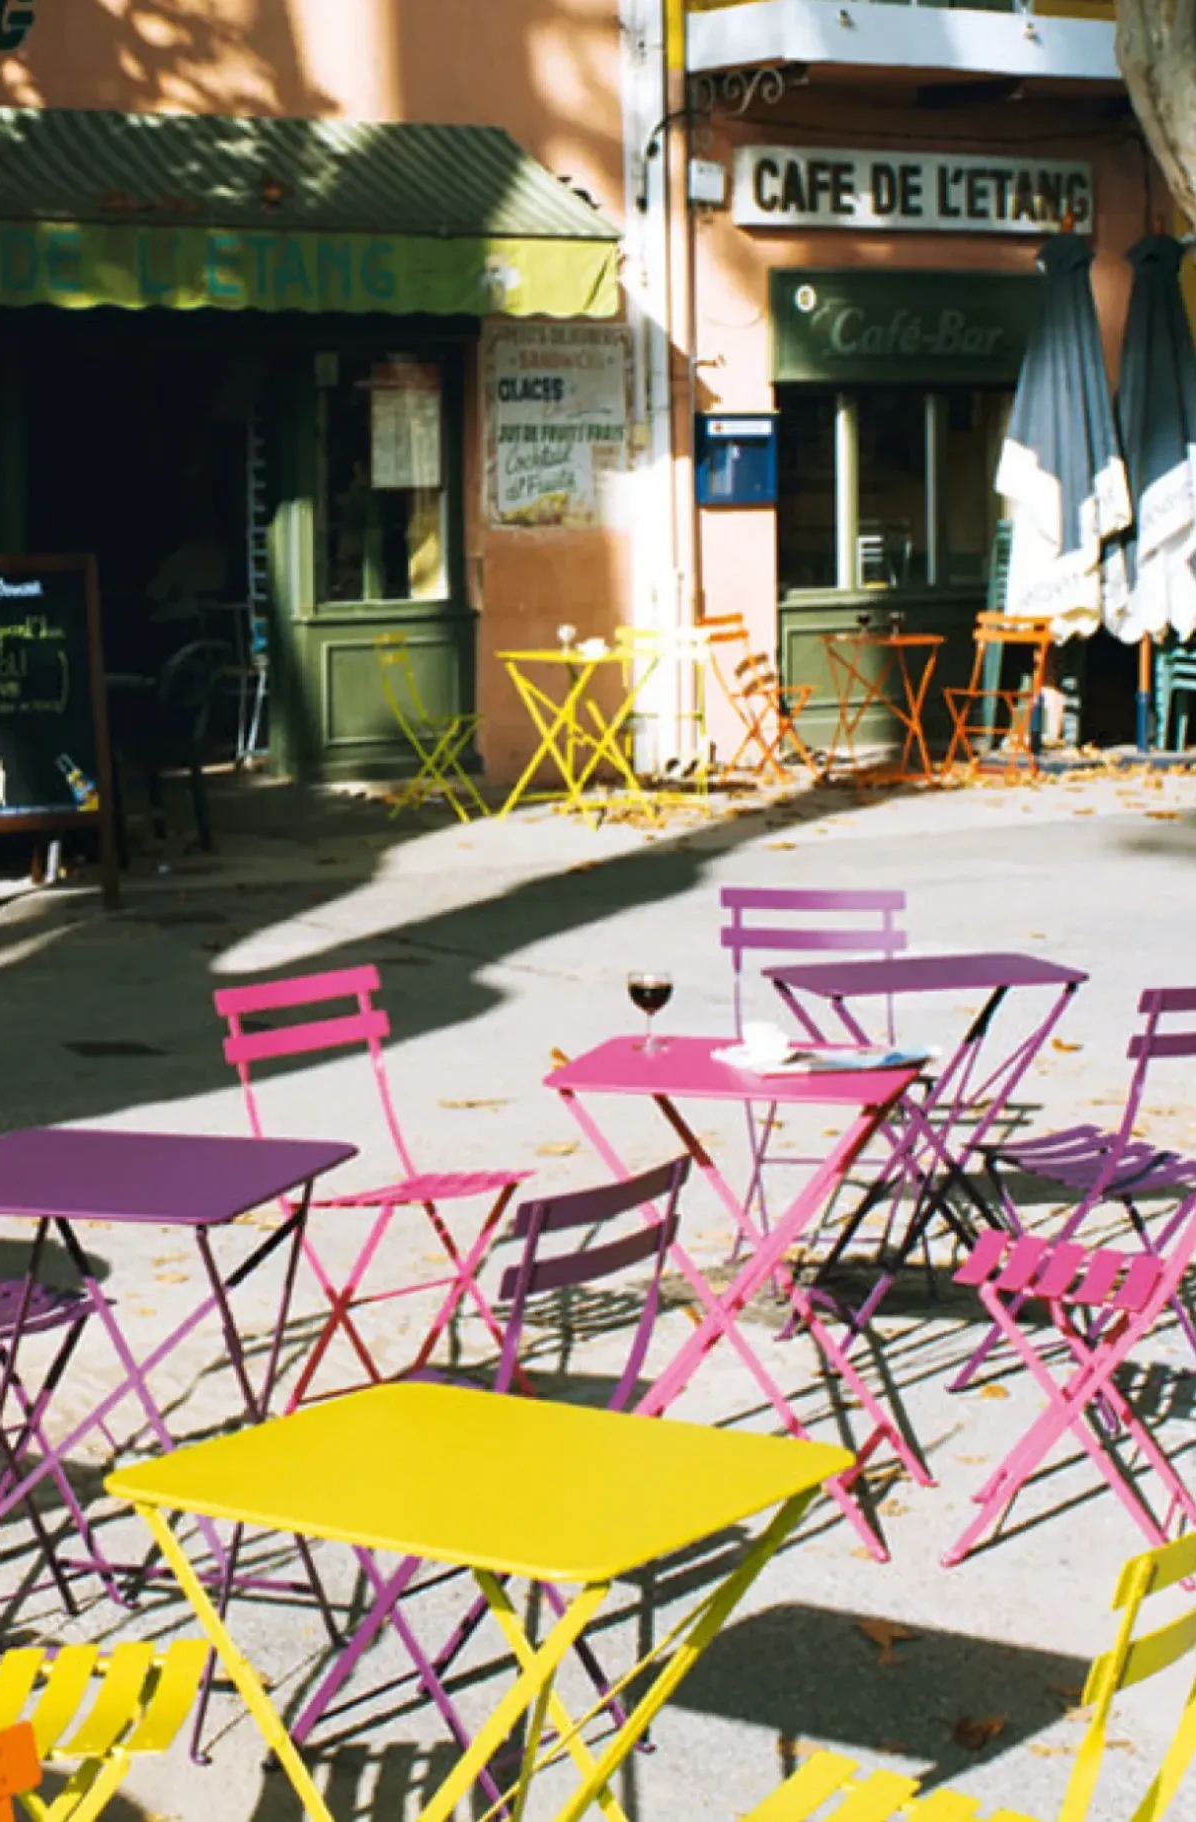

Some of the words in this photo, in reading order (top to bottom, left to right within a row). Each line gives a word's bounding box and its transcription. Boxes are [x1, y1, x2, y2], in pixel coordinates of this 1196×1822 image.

[753, 157, 856, 216] CAFE
[871, 162, 924, 218] DE
[937, 164, 1091, 224] L'ETANG
[1, 229, 84, 292] DE
